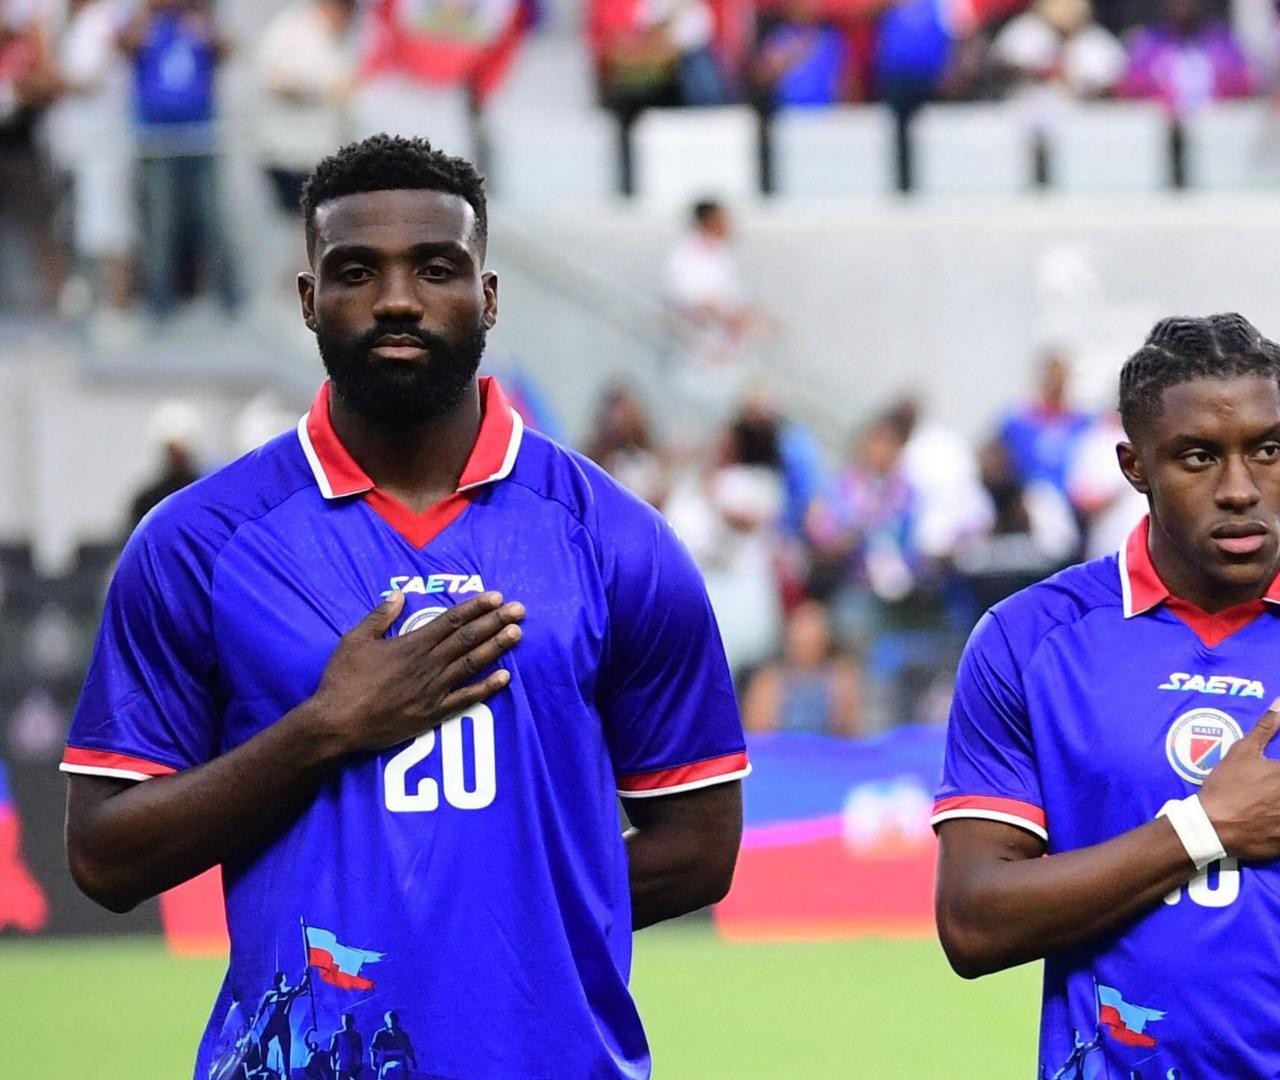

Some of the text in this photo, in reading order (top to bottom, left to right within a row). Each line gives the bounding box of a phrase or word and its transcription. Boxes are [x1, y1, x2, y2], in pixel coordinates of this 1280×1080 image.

[380, 574, 485, 596] SAETA
[1156, 672, 1265, 699] SAETA
[383, 702, 497, 812] 20
